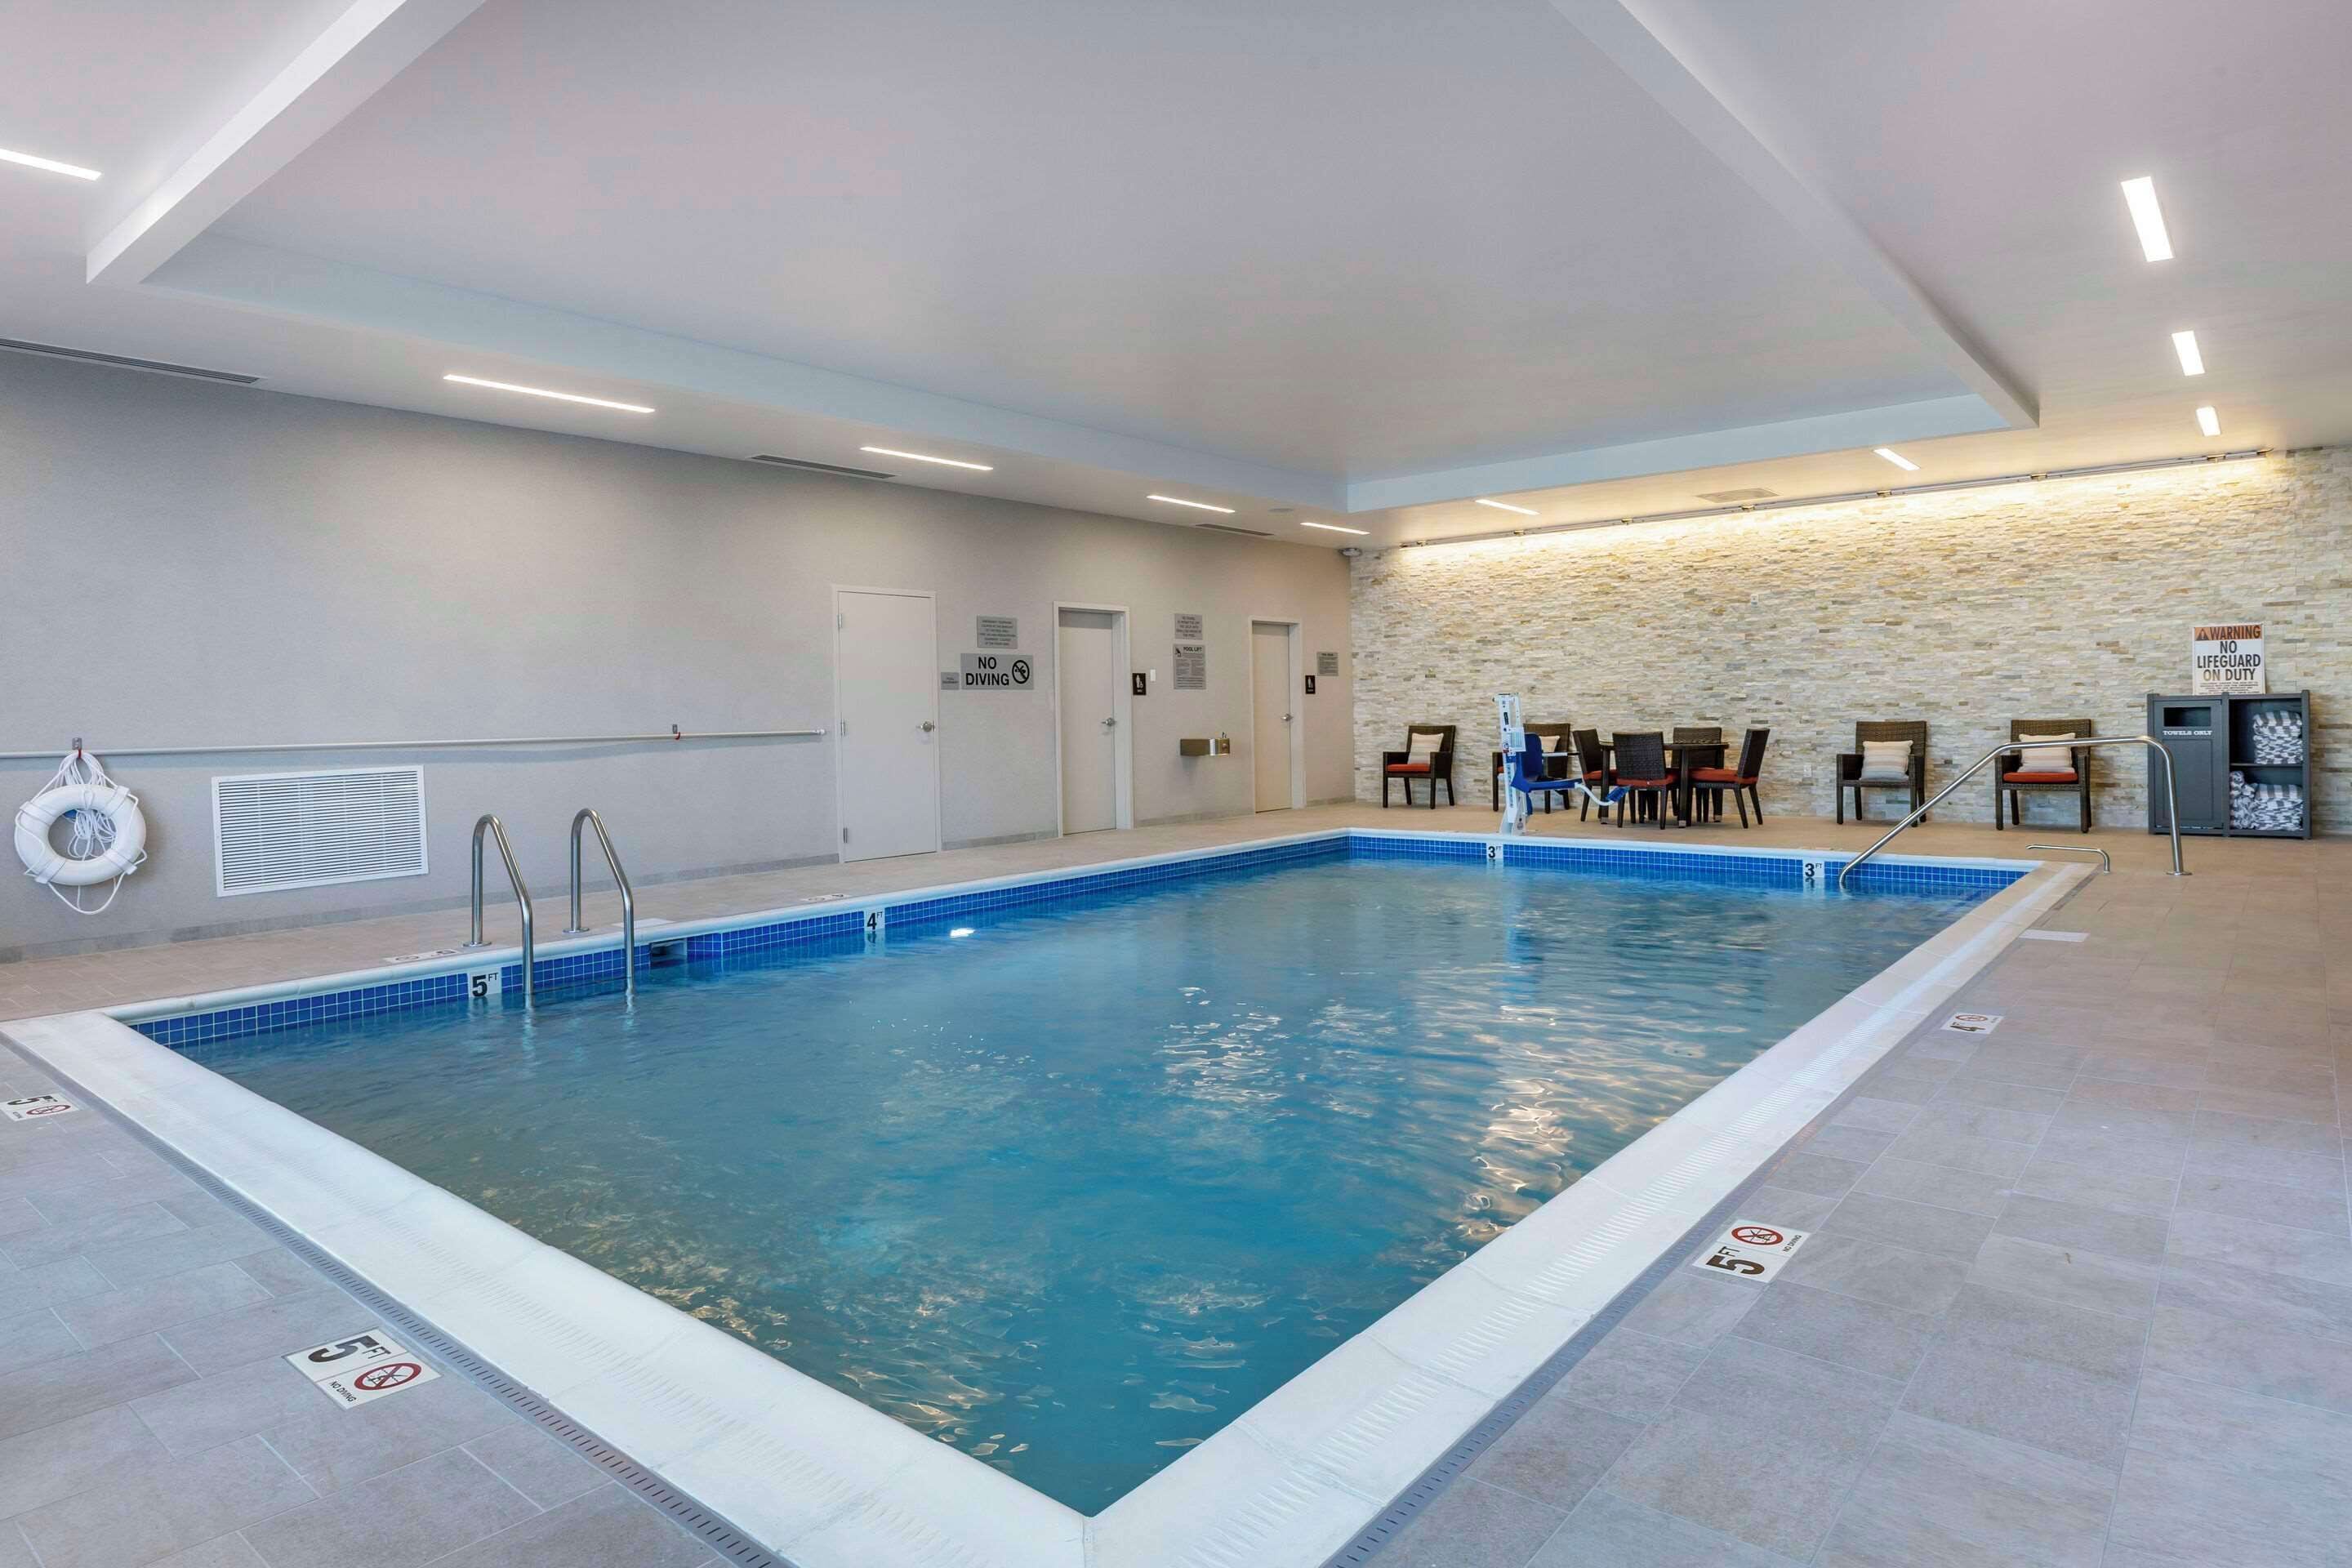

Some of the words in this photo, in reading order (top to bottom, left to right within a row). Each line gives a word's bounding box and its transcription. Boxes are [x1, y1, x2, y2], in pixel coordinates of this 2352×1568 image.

[2210, 626, 2261, 640] WARNING
[2220, 640, 2237, 653] NO
[978, 657, 996, 669] NO
[2197, 654, 2261, 668] LIFEGUARD
[965, 672, 1009, 686] DIVING
[2203, 669, 2221, 681] ON
[2225, 668, 2256, 680] DUTY
[1488, 846, 1495, 858] 3
[1805, 862, 1815, 876] 3
[867, 912, 876, 929] 4
[472, 974, 488, 996] 5
[488, 973, 498, 982] FT
[1717, 1245, 1740, 1257] FT
[1705, 1254, 1765, 1275] 5
[308, 1334, 380, 1363] 5
[362, 1346, 392, 1359] FT
[336, 1388, 357, 1401] DIVING
